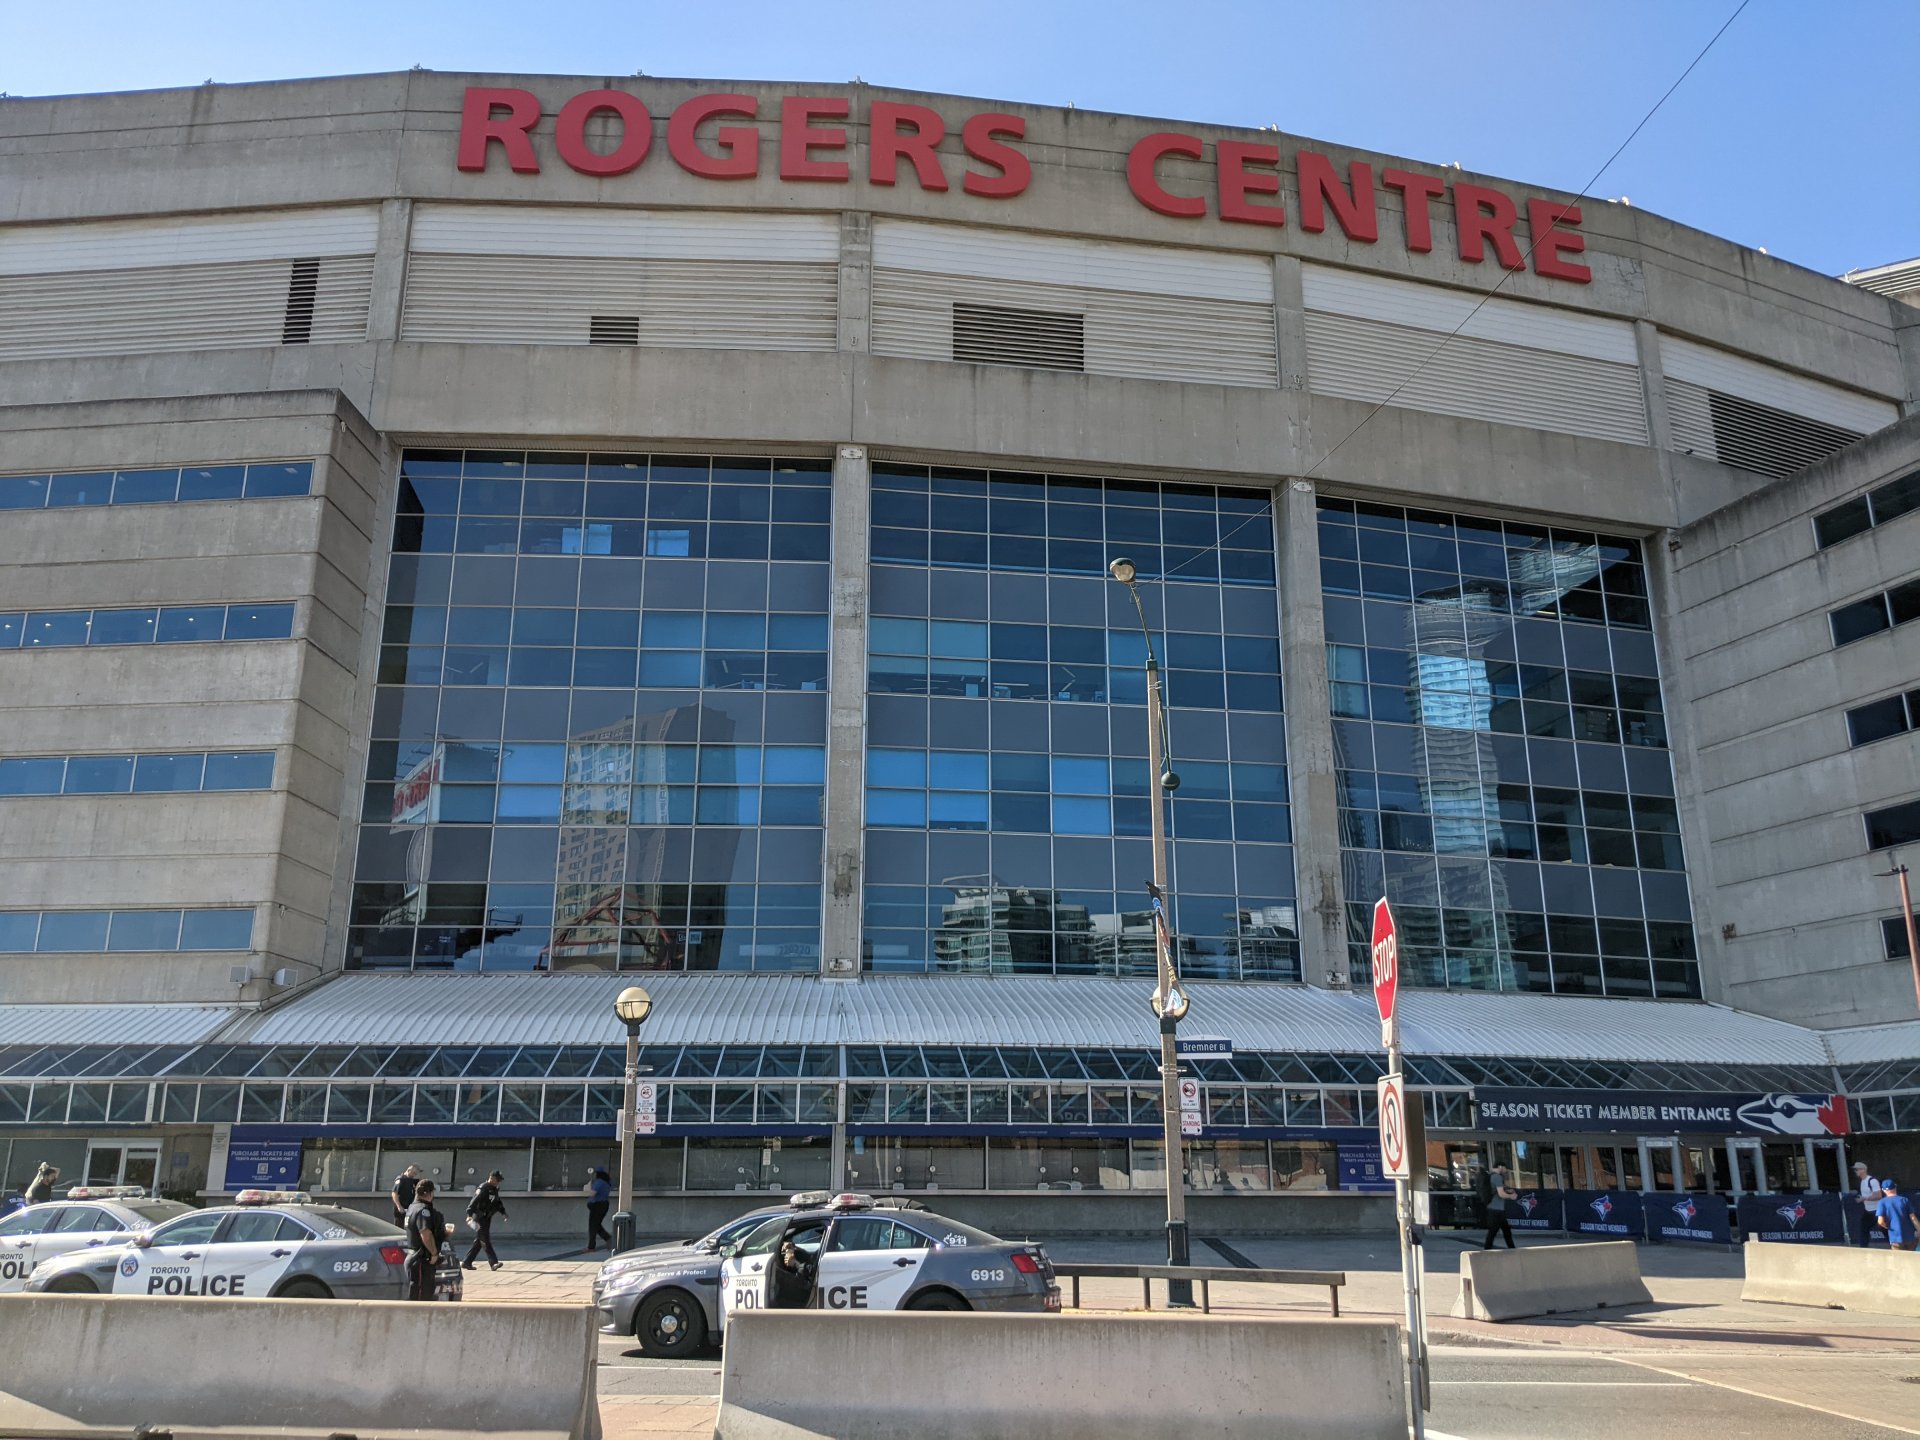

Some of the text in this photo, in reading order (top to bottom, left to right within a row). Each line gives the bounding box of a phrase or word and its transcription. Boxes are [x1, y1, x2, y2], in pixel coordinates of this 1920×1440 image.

[457, 86, 1592, 284] ROGERS CENTRE
[1374, 933, 1394, 988] STOP
[1182, 1043, 1217, 1052] Bremner
[1481, 1102, 1731, 1122] SEASON TICKET MEMBER ENTRANCE
[1532, 1219, 1548, 1227] MEMBERS
[1580, 1222, 1628, 1232] SEASON TICKET MEMBERS
[1662, 1226, 1713, 1239] SEASON TICKET MEMBERS
[1762, 1232, 1782, 1240] SEASON
[1800, 1231, 1824, 1239] MEMBERS
[334, 1261, 368, 1272] 6924
[971, 1270, 1004, 1281] 6913
[147, 1275, 246, 1296] POLICE
[736, 1279, 758, 1287] TORONTO
